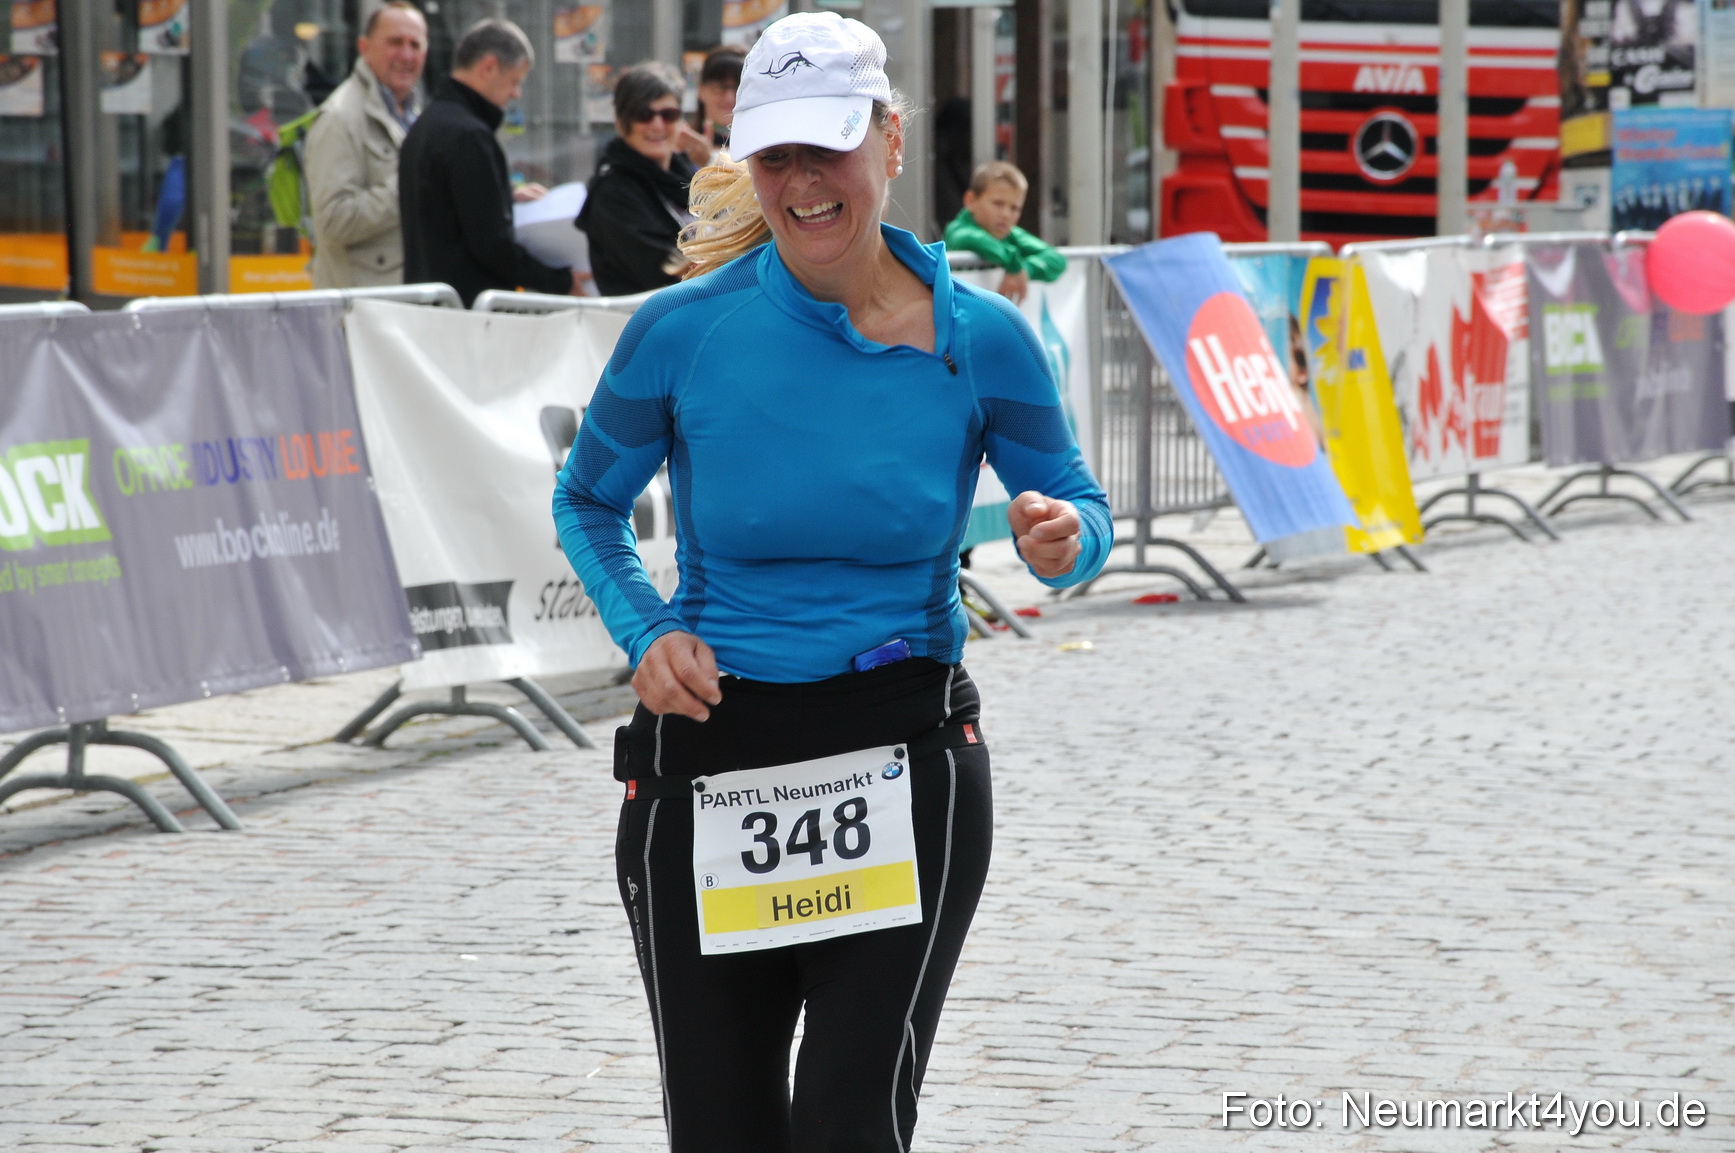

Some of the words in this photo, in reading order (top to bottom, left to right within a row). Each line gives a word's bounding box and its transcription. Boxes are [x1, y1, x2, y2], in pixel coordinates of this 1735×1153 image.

[1353, 62, 1426, 94] AVIA
[840, 109, 863, 140] sailfish
[700, 788, 770, 810] PARTL
[772, 771, 874, 802] Neumarkt
[740, 796, 871, 874] 348
[705, 876, 715, 888] B
[771, 884, 852, 922] Heidi
